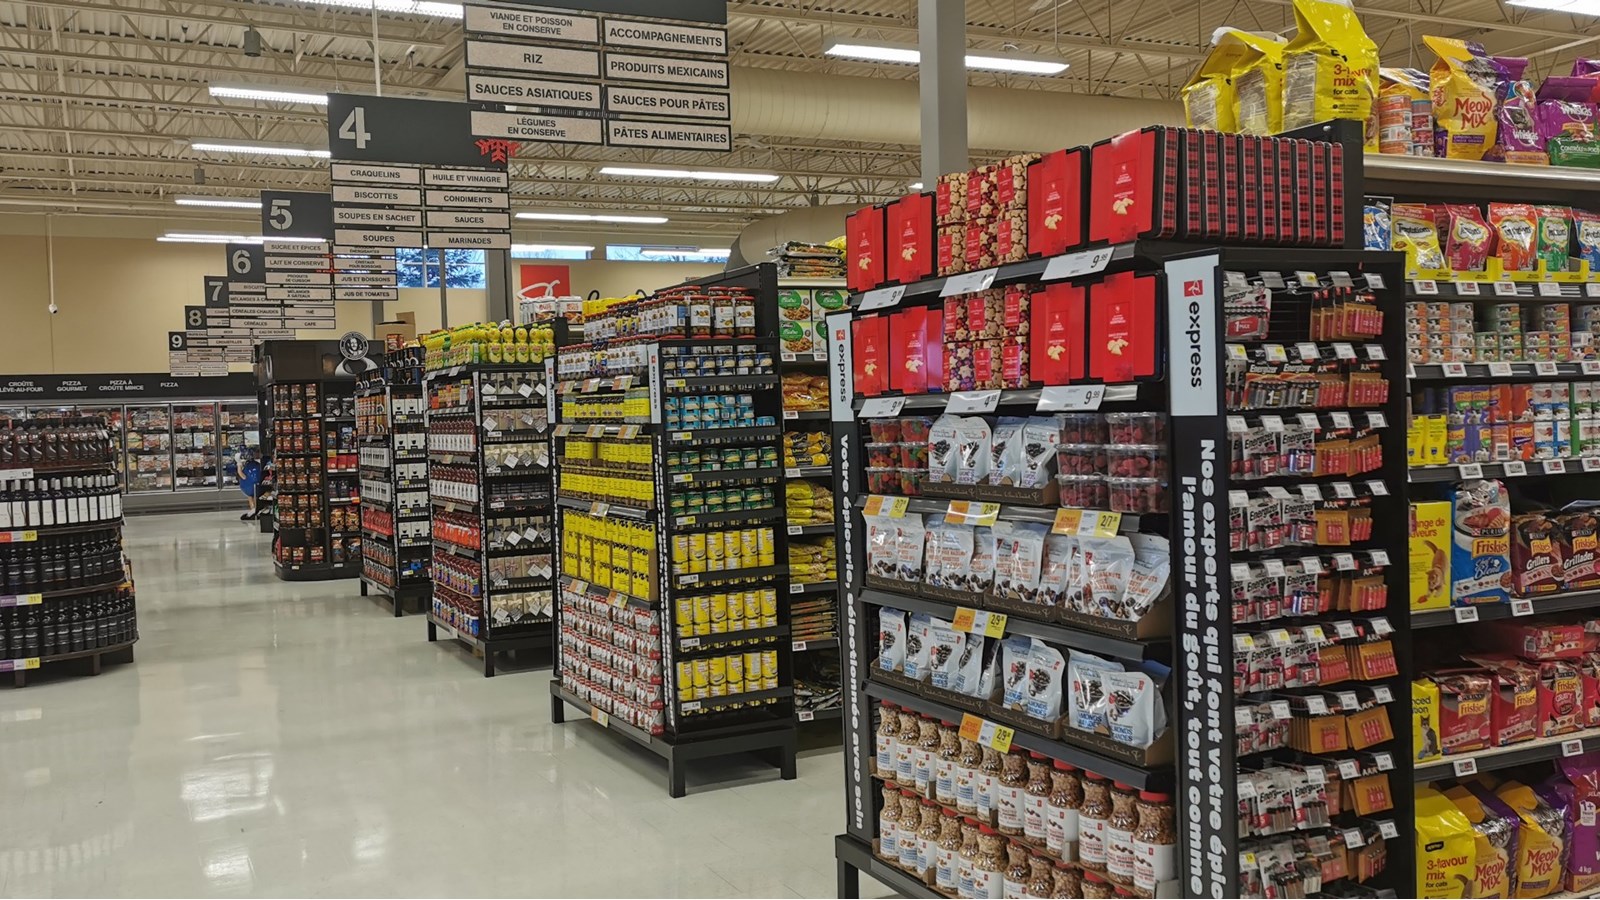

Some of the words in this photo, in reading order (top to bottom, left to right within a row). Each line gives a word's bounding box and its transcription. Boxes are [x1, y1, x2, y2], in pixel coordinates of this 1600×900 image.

[490, 12, 521, 22] VIANDE
[523, 15, 533, 23] ET
[535, 16, 573, 27] POISSON
[502, 23, 514, 32] EN
[517, 24, 562, 36] CONSERVE
[609, 27, 723, 47] ACCOMPAGNEMENTS
[523, 53, 543, 64] RIZ
[610, 61, 665, 75] PRODUITS
[667, 65, 725, 79] MEXICAINS
[1333, 77, 1356, 87] mix
[475, 83, 523, 97] SAUCES
[526, 87, 593, 102] ASIATIQUES
[612, 94, 657, 108] SAUCES
[659, 97, 690, 110] POUR
[692, 97, 726, 112] PÂTES
[338, 106, 371, 149] 4
[516, 117, 557, 128] LÉGUMES
[507, 126, 520, 136] EN
[521, 128, 566, 138] CONSERVE
[613, 126, 648, 139] PÂTES
[651, 129, 727, 144] ALIMENTAIRES
[350, 169, 401, 179] CRAQUELINS
[432, 173, 454, 182] HUILE
[467, 175, 502, 183] VINAIGRE
[354, 191, 399, 200] BISCOTTES
[443, 195, 493, 204] CONDIMENTS
[269, 199, 293, 230] 5
[338, 212, 371, 221] SOUPES
[372, 213, 384, 222] EN
[385, 213, 416, 223] SACHET
[454, 216, 485, 224] SAUCES
[301, 243, 321, 251] ÉPICES
[362, 234, 395, 243] SOUPES
[448, 237, 492, 245] MARINADES
[232, 249, 251, 274] 6
[208, 281, 223, 302] 7
[188, 309, 203, 326] 8
[171, 334, 183, 348] 9
[1183, 301, 1202, 388] express
[837, 344, 847, 402] express
[8, 379, 34, 387] CROÛTE
[1244, 431, 1275, 449] Energizer
[1282, 431, 1313, 445] Energizer
[841, 434, 850, 494] Votre
[1201, 439, 1217, 497] Nos
[1250, 503, 1279, 520] Energizer
[1284, 501, 1315, 515] Energizer
[1181, 473, 1197, 586] l'amour
[1435, 517, 1445, 527] de
[842, 496, 854, 590] épicerie,
[1410, 530, 1437, 539] aveurs
[1476, 539, 1509, 554] Friskies
[1202, 501, 1221, 622] experts
[1526, 555, 1550, 570] Grillers
[1564, 551, 1594, 570] Grillades
[1184, 591, 1200, 630] du
[1203, 626, 1222, 674] qui
[847, 592, 860, 730] sélectionnée
[1182, 633, 1203, 710] goût,
[1207, 679, 1223, 743] font
[852, 732, 861, 783] avec
[1187, 716, 1203, 782] tout
[1208, 748, 1224, 831] votre
[855, 785, 864, 830] soin
[1188, 786, 1203, 895] comme
[1426, 855, 1469, 871] 3-flavour
[1525, 842, 1560, 868] Meow
[1426, 871, 1446, 880] mix
[1529, 862, 1554, 879] Mix
